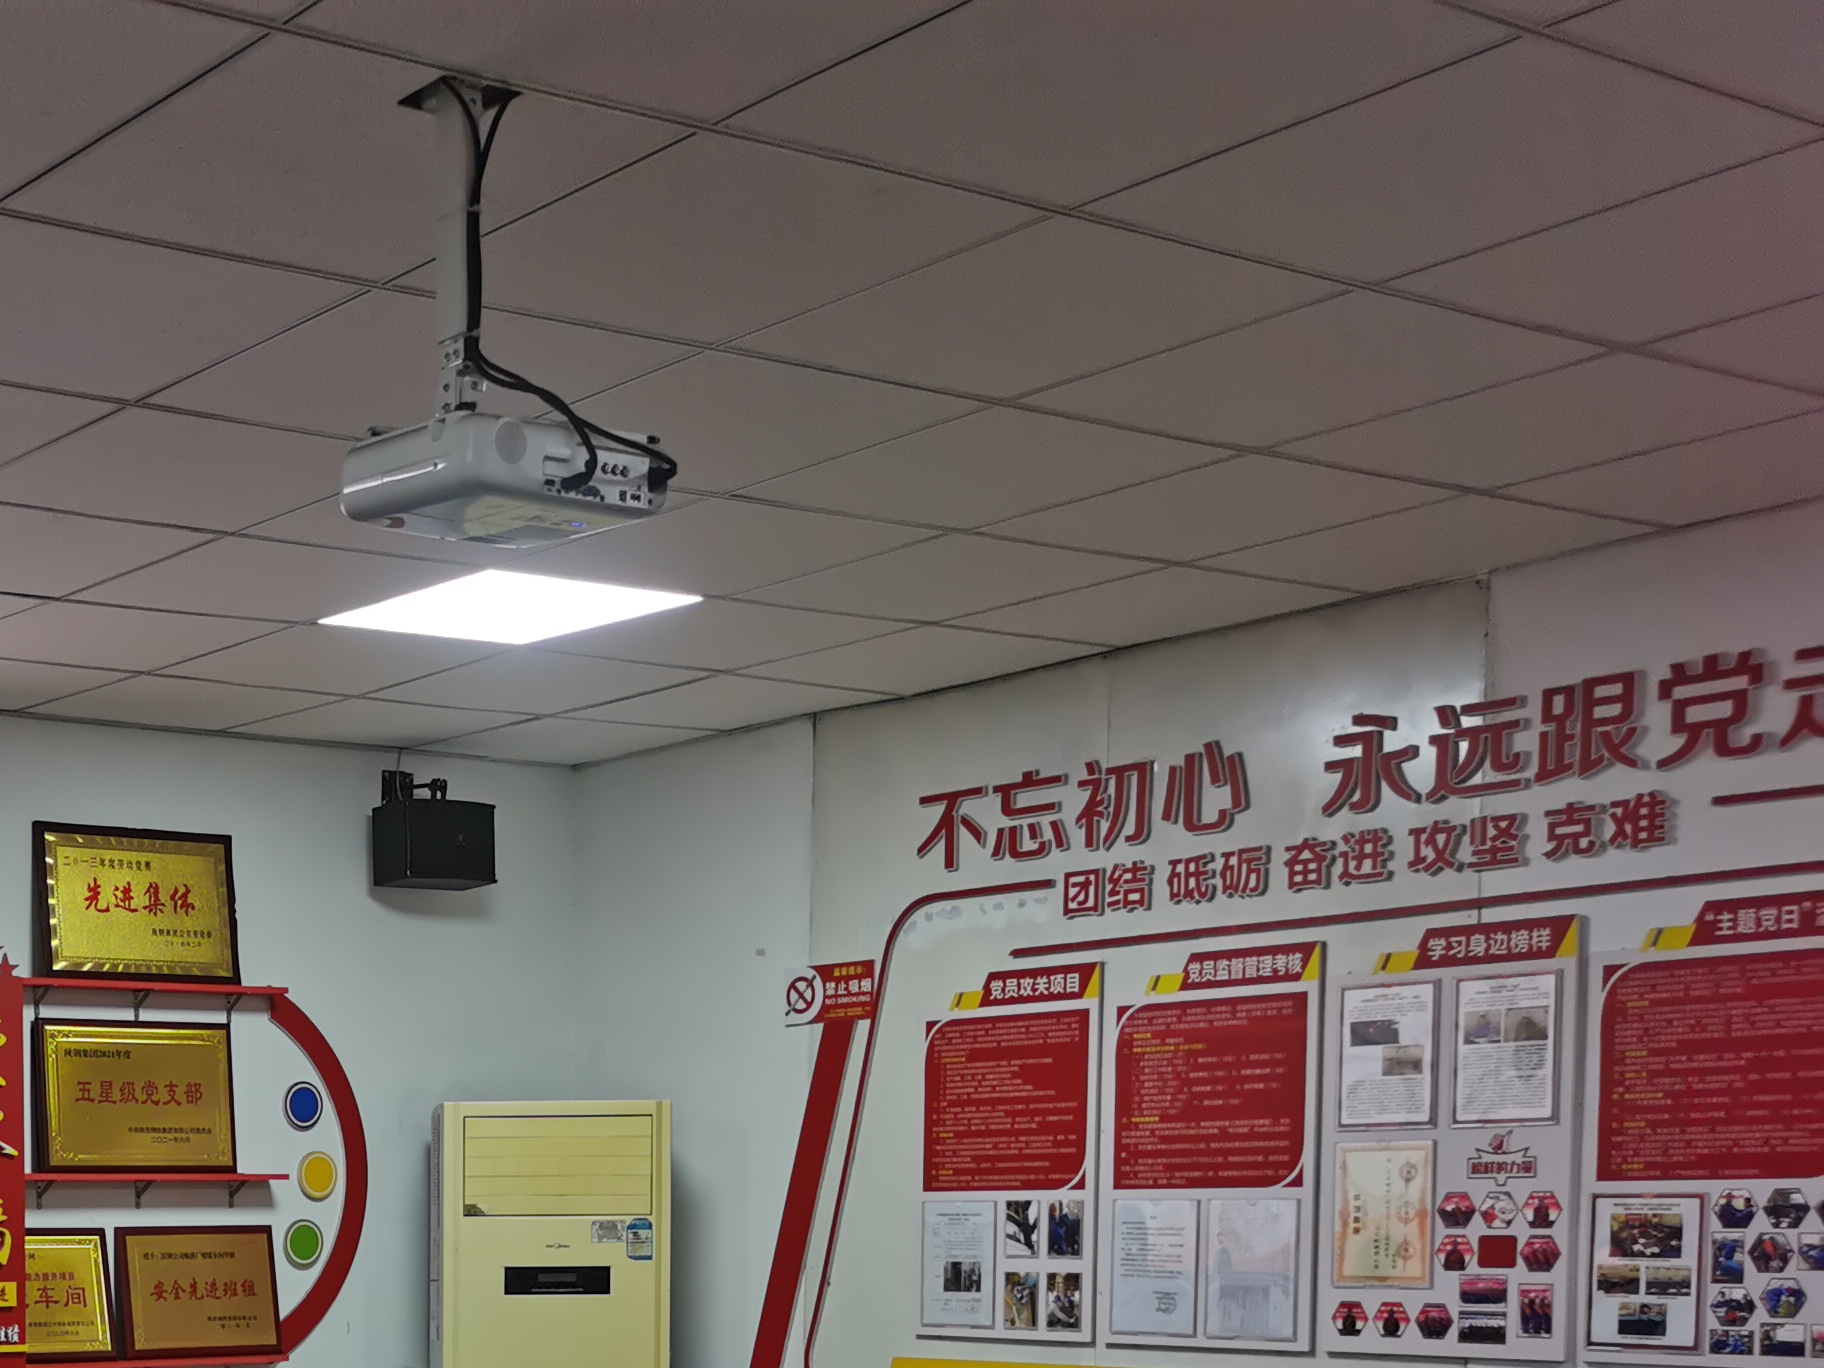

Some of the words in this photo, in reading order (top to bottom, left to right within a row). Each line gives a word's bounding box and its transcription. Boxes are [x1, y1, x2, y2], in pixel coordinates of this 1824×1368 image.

[916, 739, 1253, 875] 不忘初心
[1063, 862, 1153, 918] 团结
[1167, 843, 1270, 905] 砥砺
[1284, 824, 1391, 894] 奋进
[1408, 807, 1527, 875] 攻坚
[1544, 790, 1673, 858] 克难
[84, 877, 196, 917] 先进集体
[1704, 899, 1824, 936] “主题党日”
[1427, 928, 1552, 961] 学习身边榜样
[1187, 953, 1303, 984] 党员监督管理考核
[825, 978, 872, 996] 禁止吸烟
[837, 995, 871, 1004] SMOKING
[989, 974, 1081, 1000] 党员攻关项目
[75, 1079, 203, 1107] 五星级党支部
[25, 1285, 88, 1310] 车间
[150, 1277, 257, 1302] 安全先进班组
